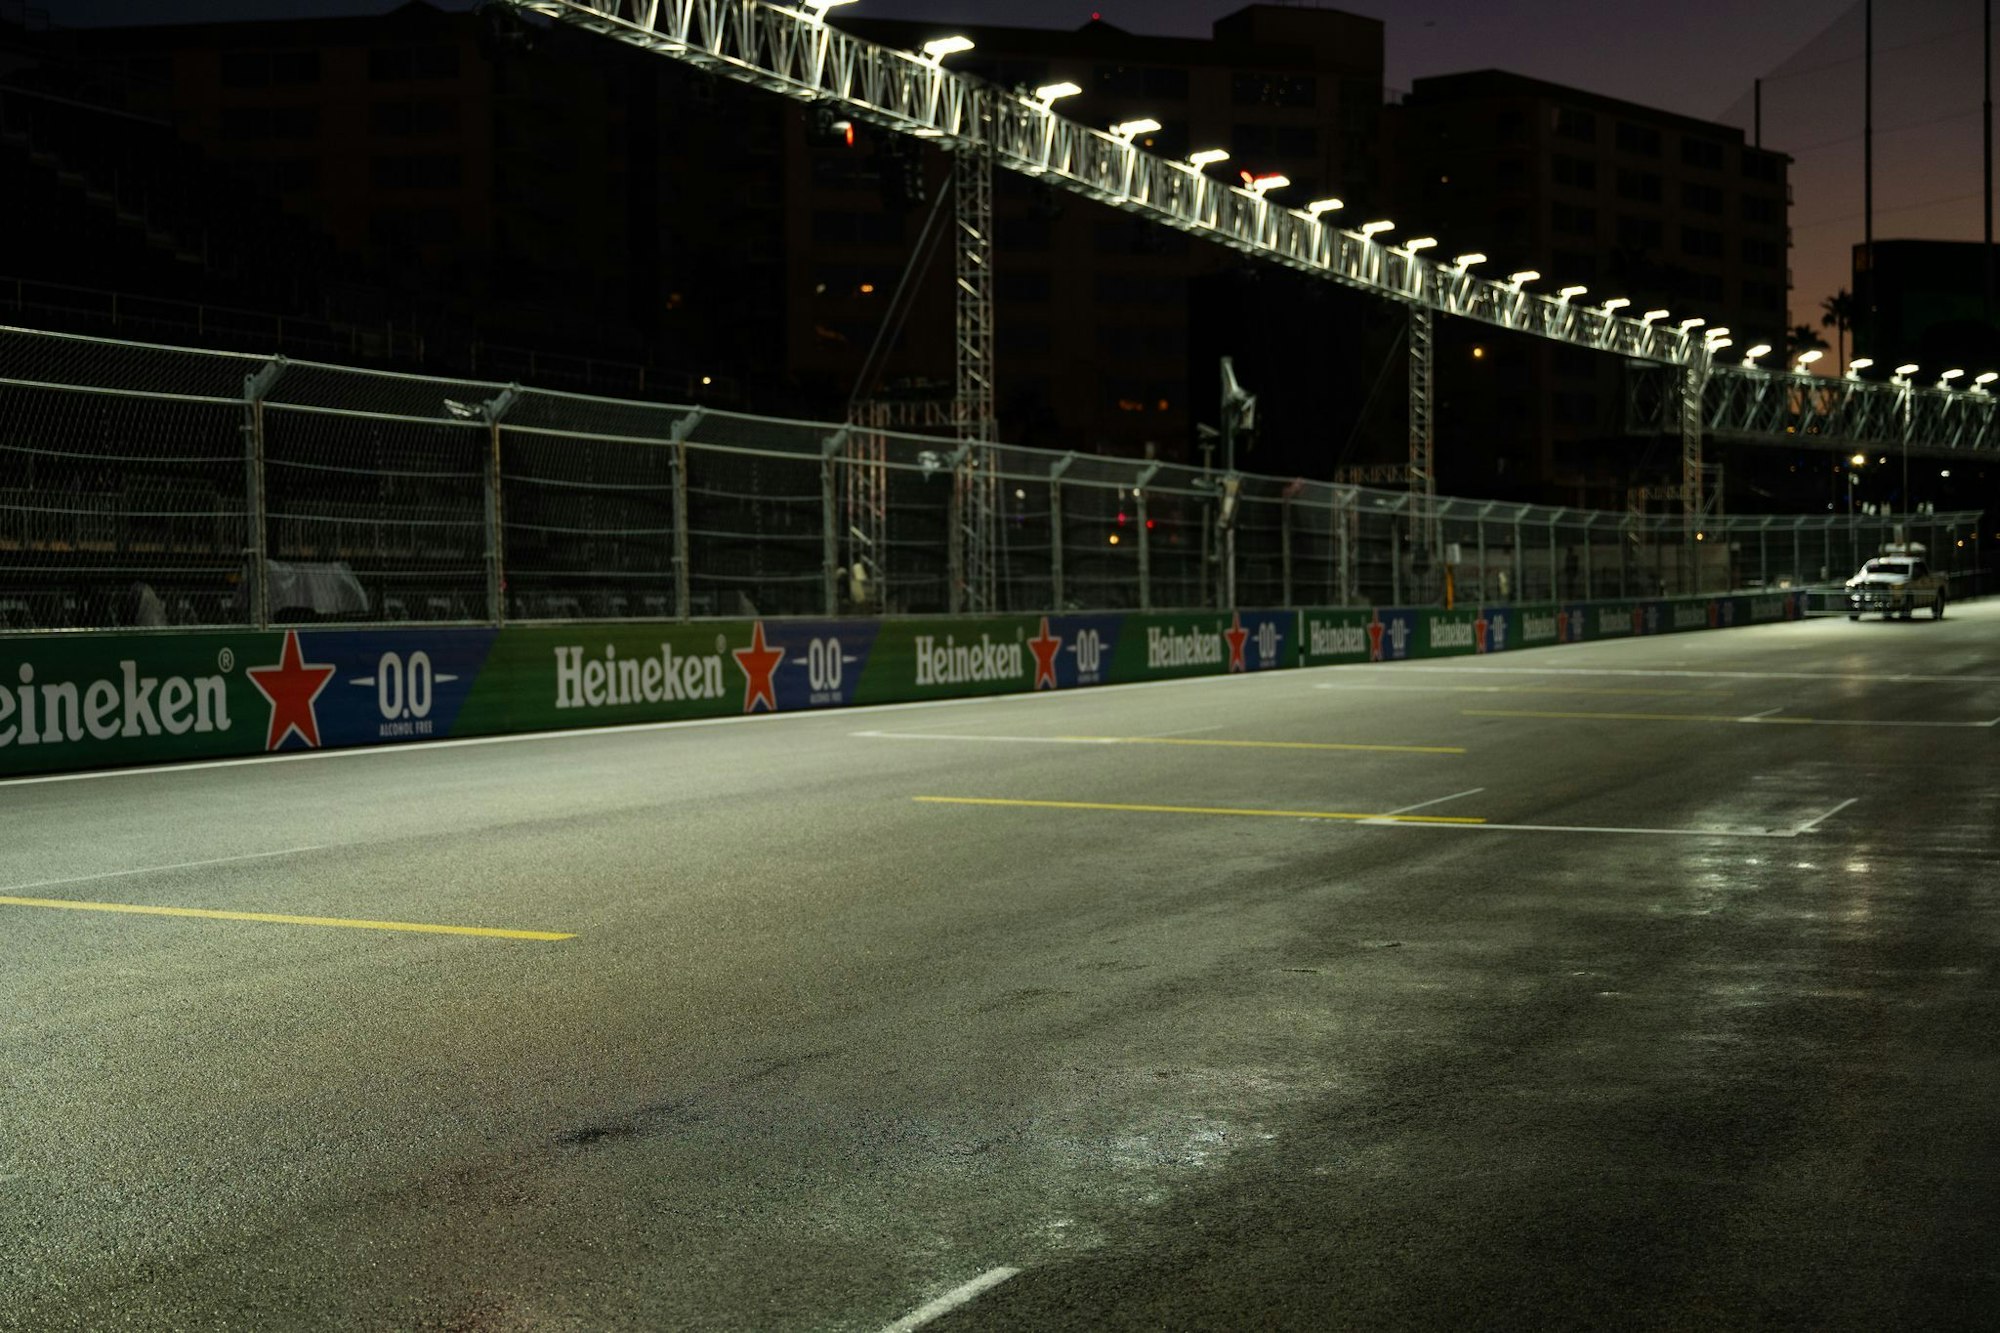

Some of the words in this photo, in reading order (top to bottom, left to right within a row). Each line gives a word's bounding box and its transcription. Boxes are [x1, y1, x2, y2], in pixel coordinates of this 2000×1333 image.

[808, 637, 842, 691] 0.0
[915, 634, 1023, 685] Heineken
[1147, 625, 1222, 668] Heineken
[378, 650, 432, 720] 0.0
[555, 643, 725, 709] Heineken
[379, 721, 414, 737] ALCOHOL
[415, 720, 433, 735] FREE
